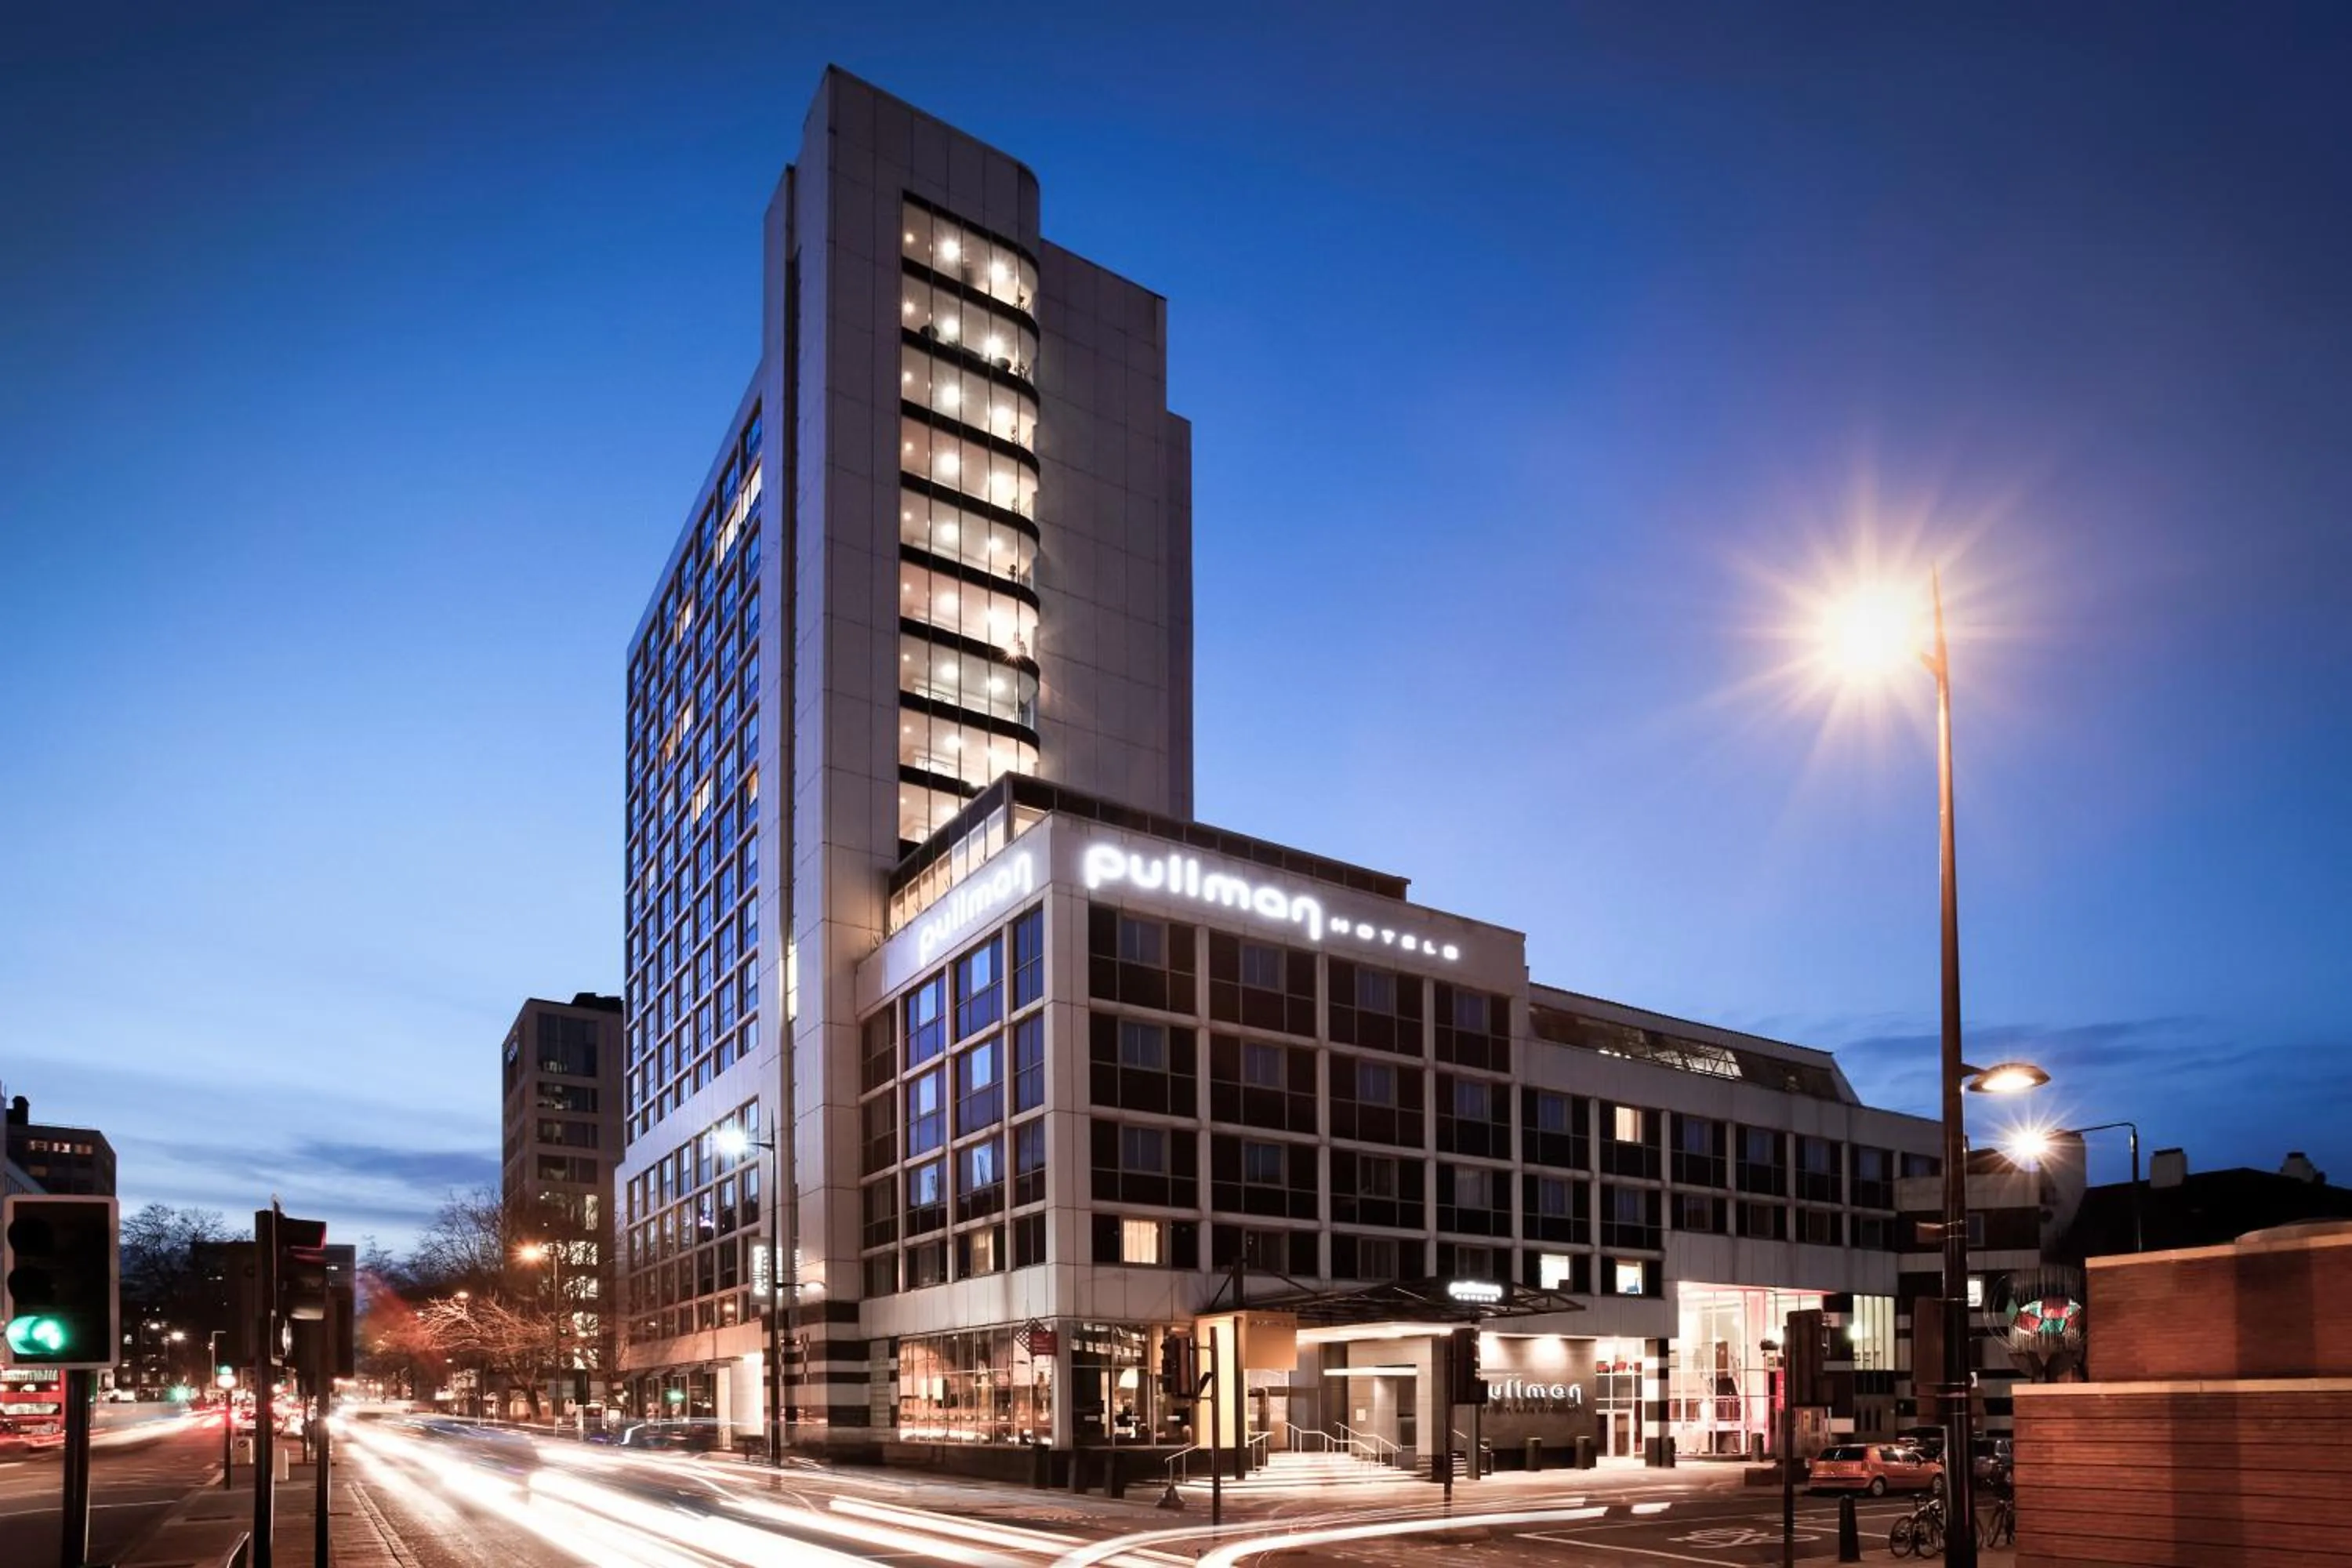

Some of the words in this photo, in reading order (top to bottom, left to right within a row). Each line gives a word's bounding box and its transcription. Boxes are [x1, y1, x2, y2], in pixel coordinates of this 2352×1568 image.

[918, 850, 1033, 968] pullman
[1082, 844, 1323, 942] pullman
[1488, 1379, 1581, 1405] ullman
